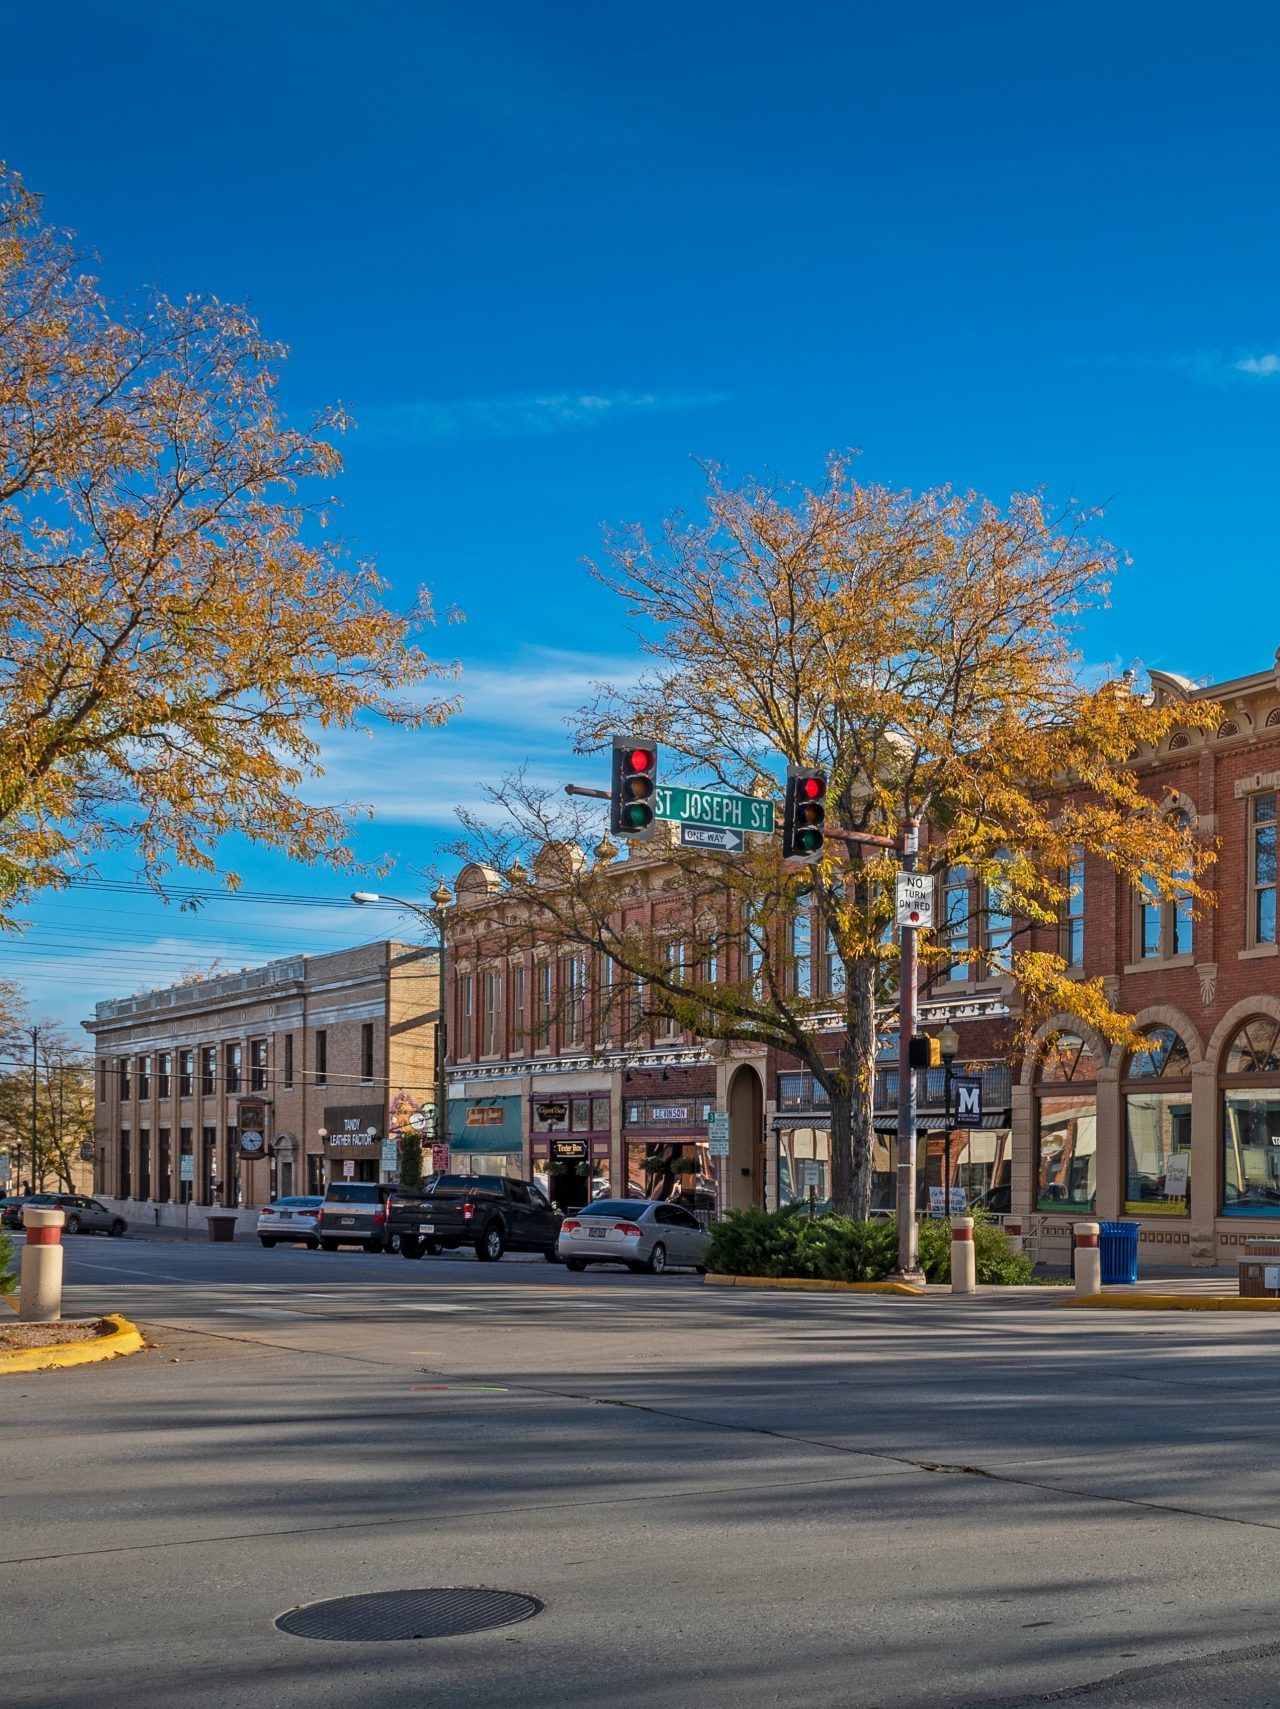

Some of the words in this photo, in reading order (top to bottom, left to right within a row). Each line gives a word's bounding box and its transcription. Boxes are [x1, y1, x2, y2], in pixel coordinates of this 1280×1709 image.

[655, 788, 673, 815] ST
[680, 793, 742, 825] JOSEPH
[750, 802, 769, 828] ST
[687, 830, 704, 841] ONE
[707, 833, 725, 843] WAY
[907, 877, 923, 889] NO
[905, 889, 926, 900] TURN
[899, 899, 911, 909] ON
[914, 901, 931, 911] RED
[959, 1087, 980, 1114] M
[655, 1109, 686, 1118] LEVINSON
[709, 1113, 714, 1122] 3
[344, 1118, 361, 1131] TANDY
[330, 1134, 351, 1146] LEATHER
[352, 1133, 375, 1146] FACTOR
[557, 1144, 572, 1152] Tinder
[572, 1144, 582, 1152] Box
